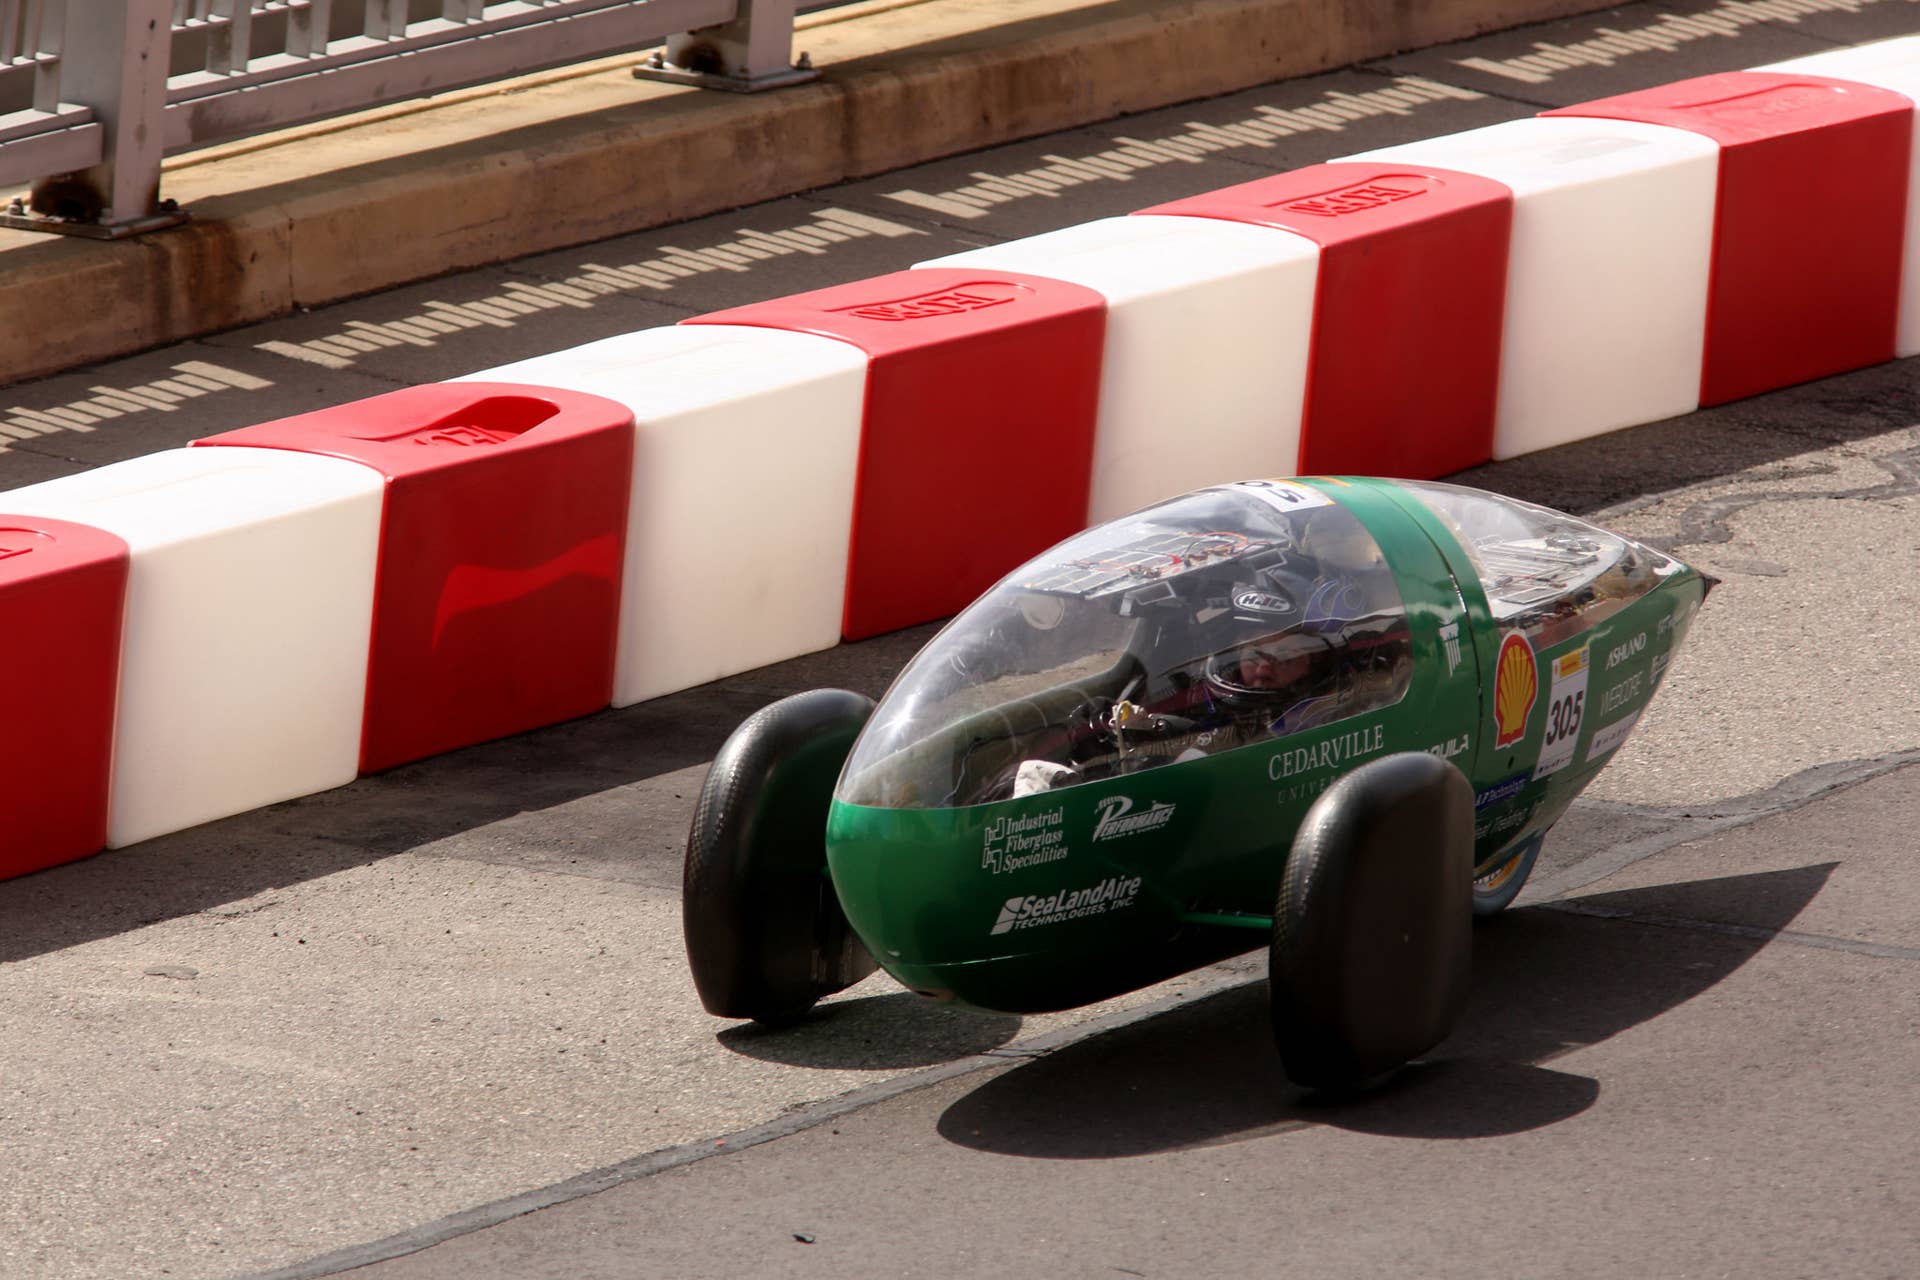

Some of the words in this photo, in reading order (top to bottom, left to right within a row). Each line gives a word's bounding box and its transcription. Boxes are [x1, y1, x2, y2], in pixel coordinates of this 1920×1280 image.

[1606, 632, 1647, 671] ASHLAND
[1546, 690, 1584, 746] 305
[1268, 724, 1385, 781] CEDARVILLE
[1006, 806, 1063, 834] Industrial
[1005, 829, 1063, 854] Fiberglass
[1003, 845, 1068, 874] Specialities
[1018, 875, 1141, 919] SeaLandAire
[1014, 903, 1106, 929] TECHNOLOGIES,
